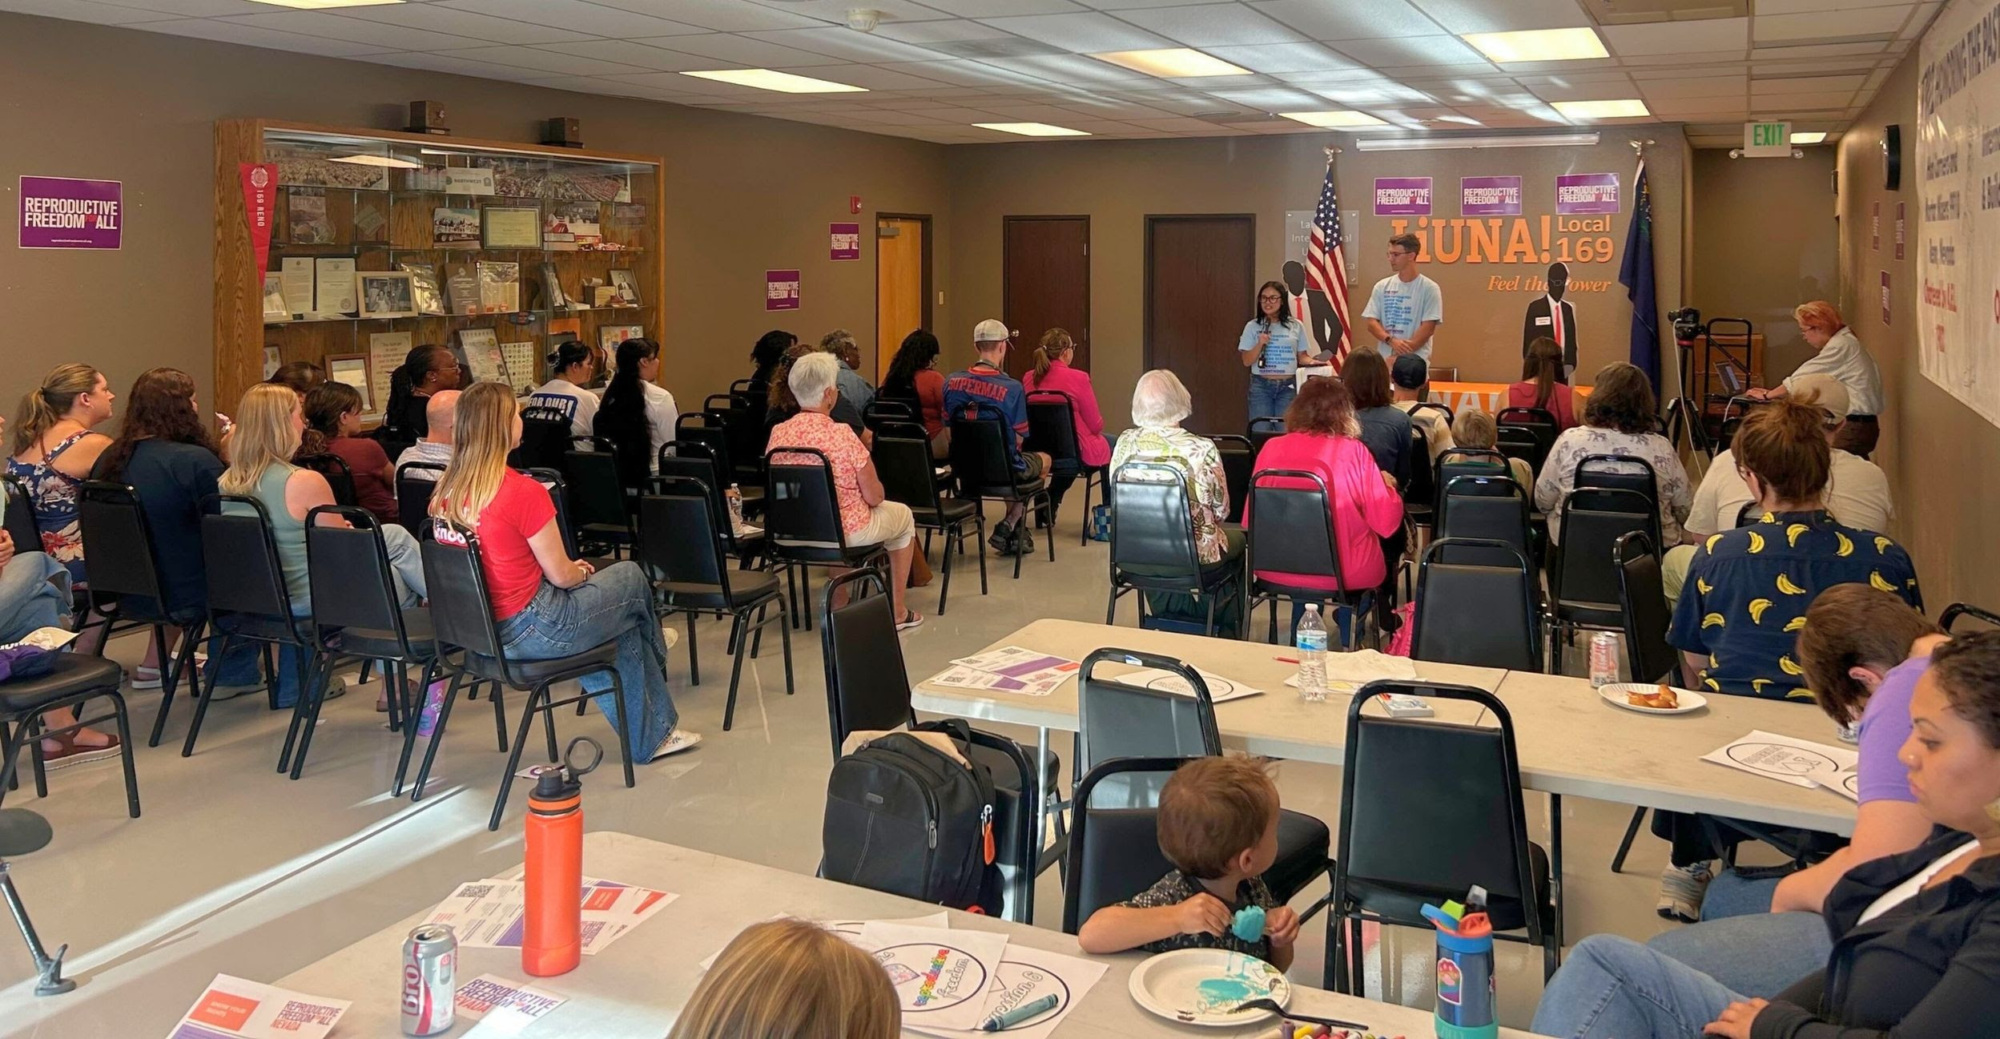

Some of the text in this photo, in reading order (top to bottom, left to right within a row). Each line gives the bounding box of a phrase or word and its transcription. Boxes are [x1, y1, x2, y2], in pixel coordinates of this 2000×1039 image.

[1753, 124, 1785, 146] EXIT
[1377, 188, 1430, 198] REPRODUCTIVE
[1464, 187, 1519, 197] REPRODUCTIVE
[1559, 185, 1616, 195] REPRODUCTIVE
[1559, 193, 1617, 203] FREEDOM ALL
[25, 197, 118, 215] REPRODUCTIVE
[256, 190, 265, 227] 169 RENO
[1377, 196, 1430, 205] FREEDOM ALL
[1464, 196, 1518, 205] FREEDOM ALL
[25, 212, 85, 229] FREEDOM
[95, 215, 118, 230] ALL
[1558, 214, 1611, 232] Local
[1556, 237, 1614, 262] 169
[1488, 275, 1520, 291] Feel
[1566, 277, 1611, 292] ower
[948, 377, 1008, 402] SUPERMAN
[456, 986, 544, 1017] FREEDOM ALL
[467, 978, 560, 1010] REPRODUCTIVE
[983, 981, 1036, 1023] estion
[285, 1000, 343, 1018] REPRODUCTIVE
[455, 995, 493, 1013] EVADA
[278, 1009, 315, 1024] FREEDOM
